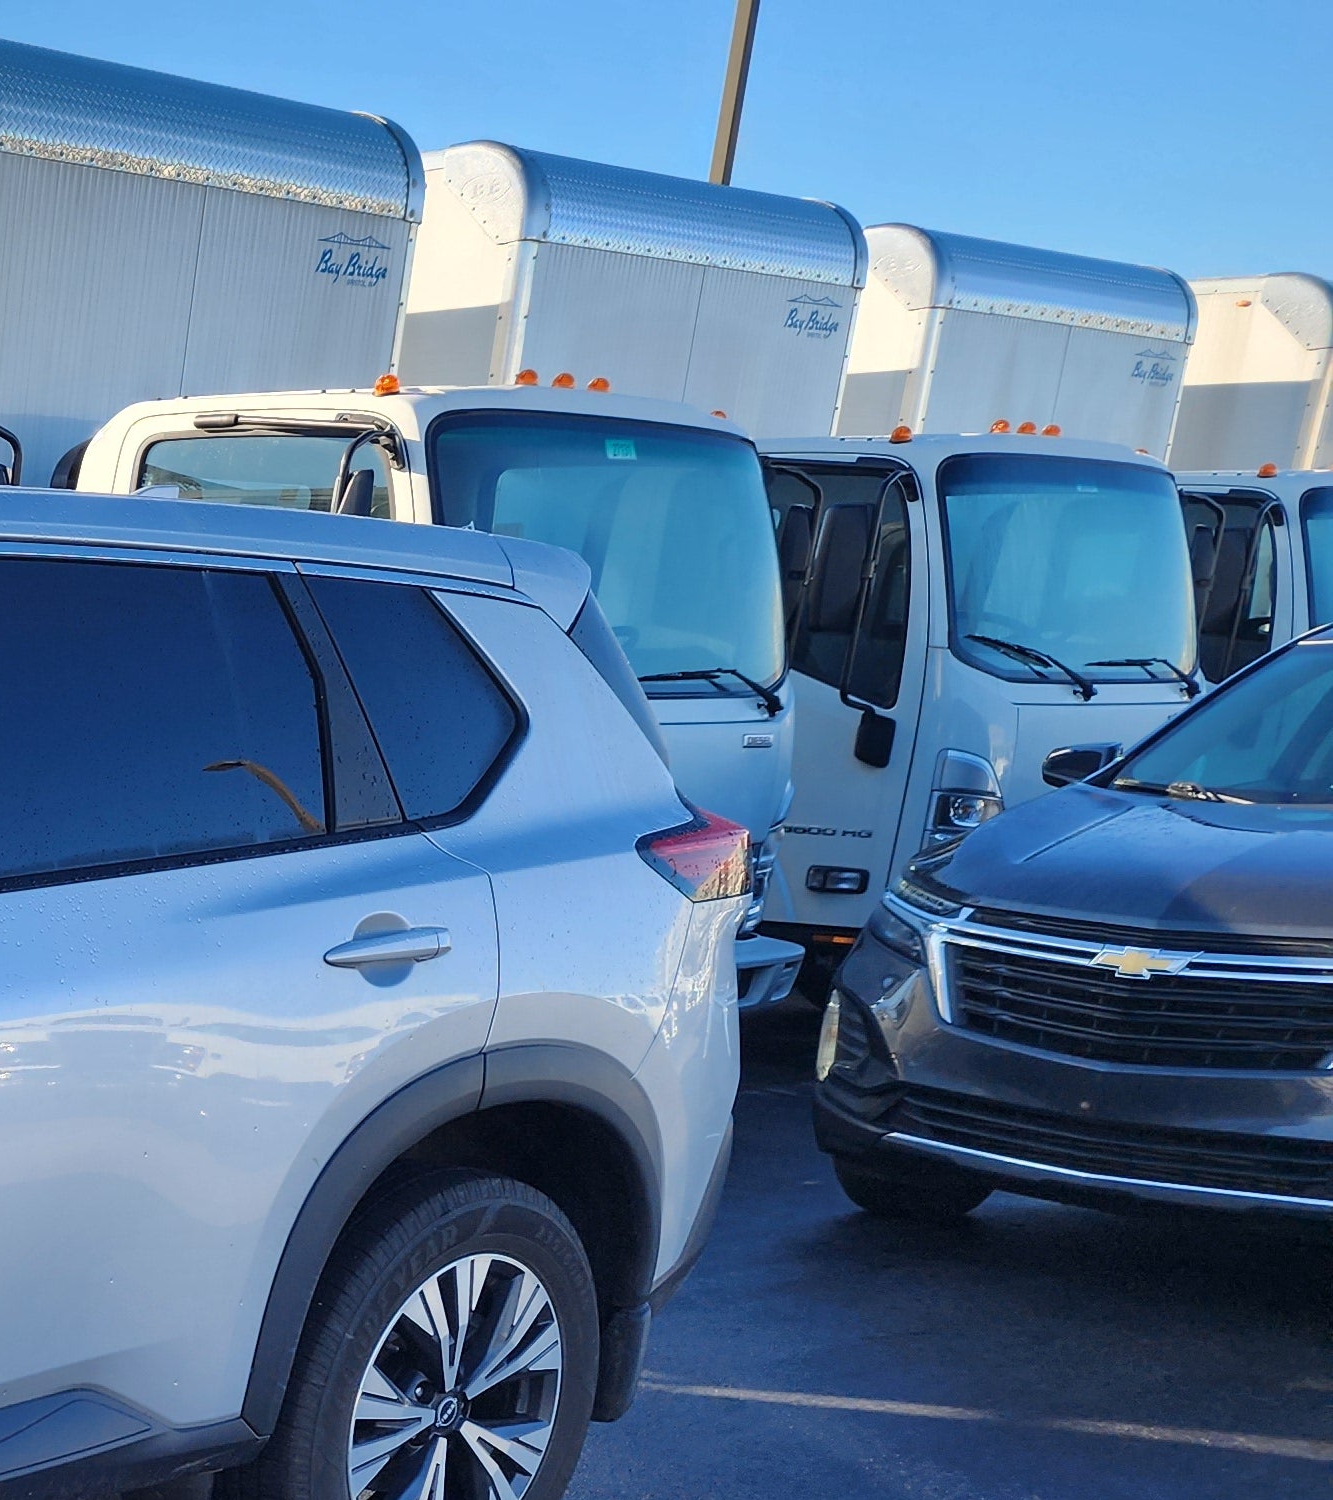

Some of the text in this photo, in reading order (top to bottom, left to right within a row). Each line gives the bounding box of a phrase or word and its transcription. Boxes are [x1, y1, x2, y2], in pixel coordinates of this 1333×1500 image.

[315, 248, 388, 287] Bay Bridge
[783, 308, 839, 338] Bay Bridge
